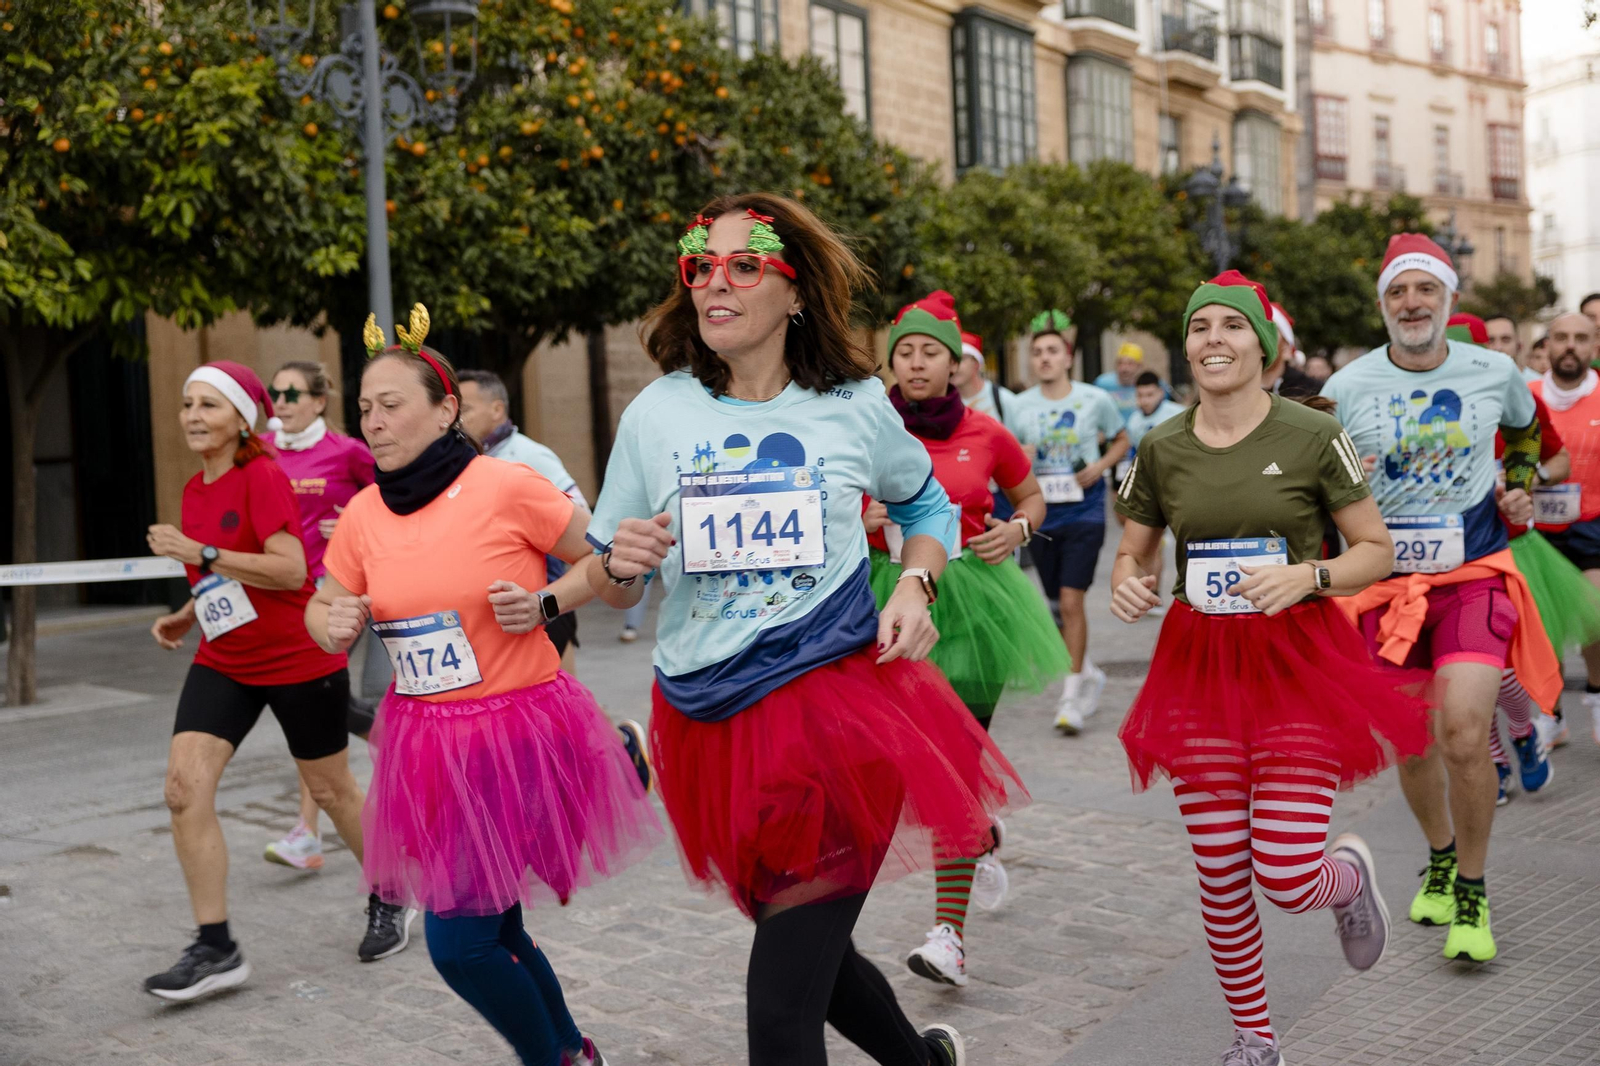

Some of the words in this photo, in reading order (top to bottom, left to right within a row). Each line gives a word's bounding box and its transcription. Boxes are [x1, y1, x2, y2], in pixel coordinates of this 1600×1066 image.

[700, 508, 804, 550] 1144
[1395, 541, 1443, 560] 297
[396, 642, 462, 678] 1174
